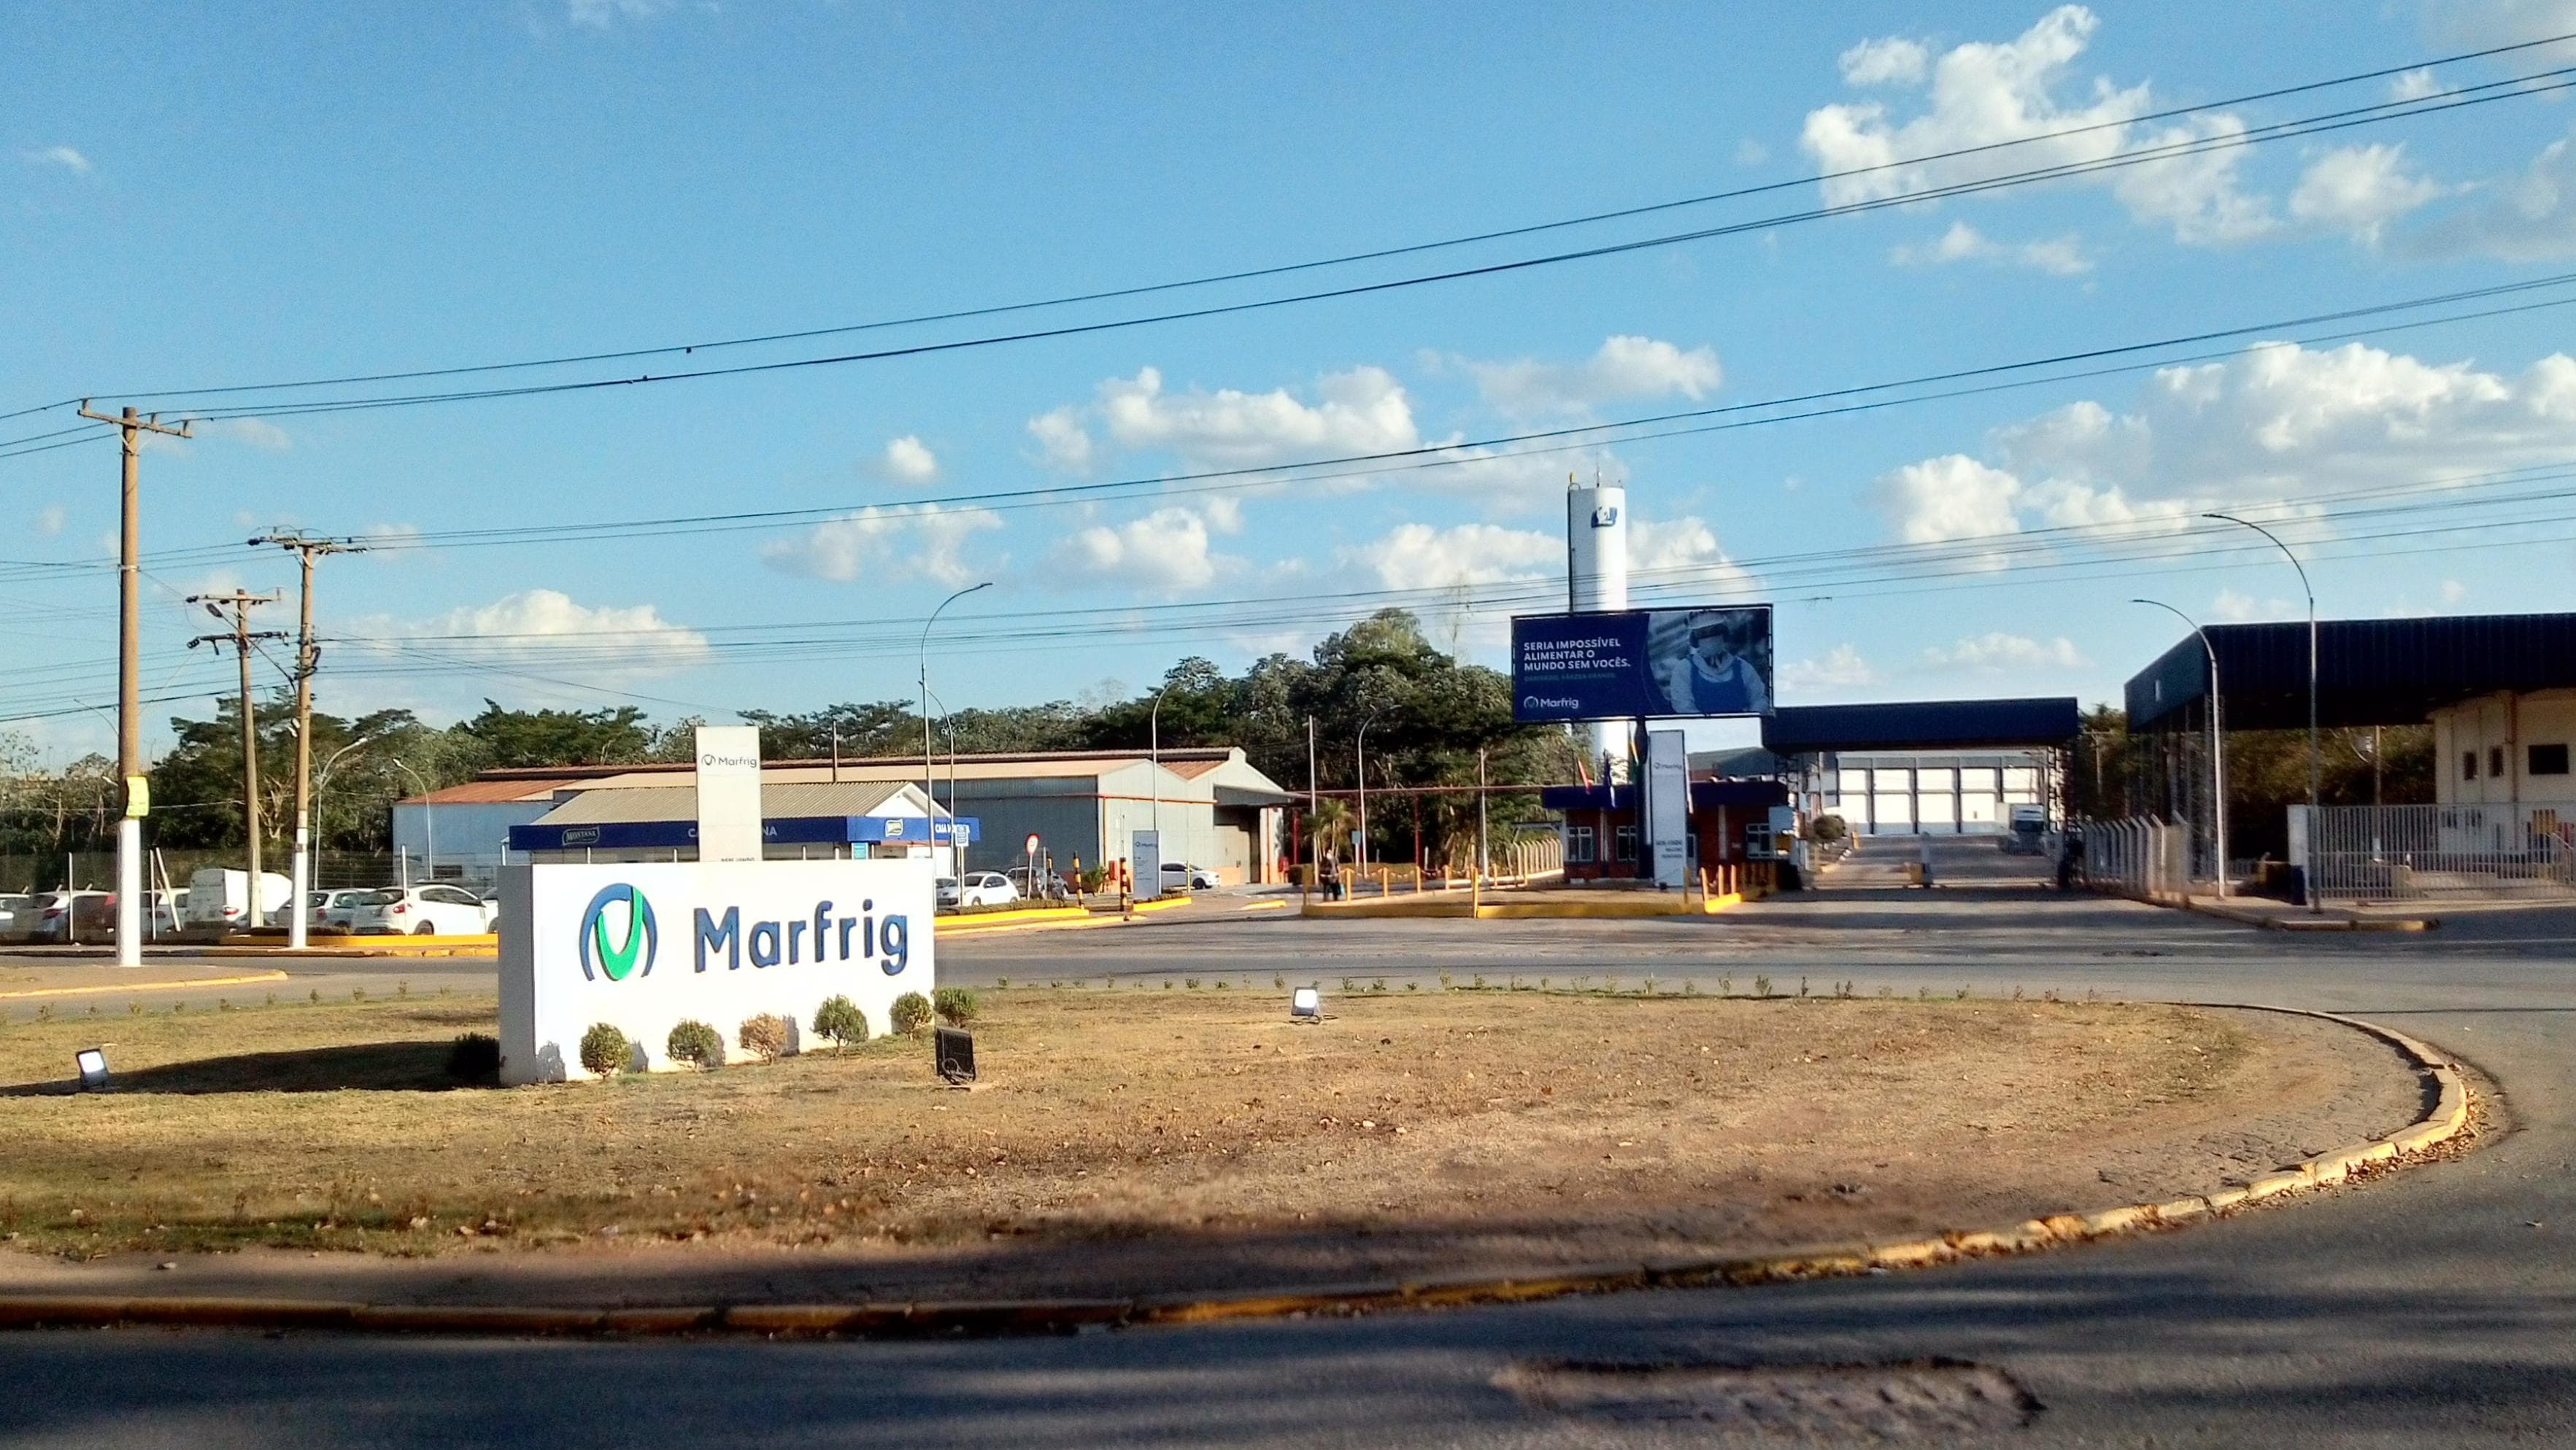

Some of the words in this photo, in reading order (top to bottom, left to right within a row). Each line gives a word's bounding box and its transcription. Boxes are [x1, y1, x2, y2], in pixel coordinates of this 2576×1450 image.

[1524, 641, 1554, 651] SERIA
[1557, 637, 1620, 649] IMPOSSÍVEL
[1524, 651, 1584, 660] ALIMENTAR
[1586, 650, 1594, 658] O
[1524, 661, 1565, 671] MUNDO
[1567, 660, 1590, 669] SEM
[1592, 656, 1631, 668] VOCÊS.
[1540, 697, 1579, 709] Marfrig
[718, 757, 757, 768] Marfrig
[693, 898, 908, 976] Marfrig
